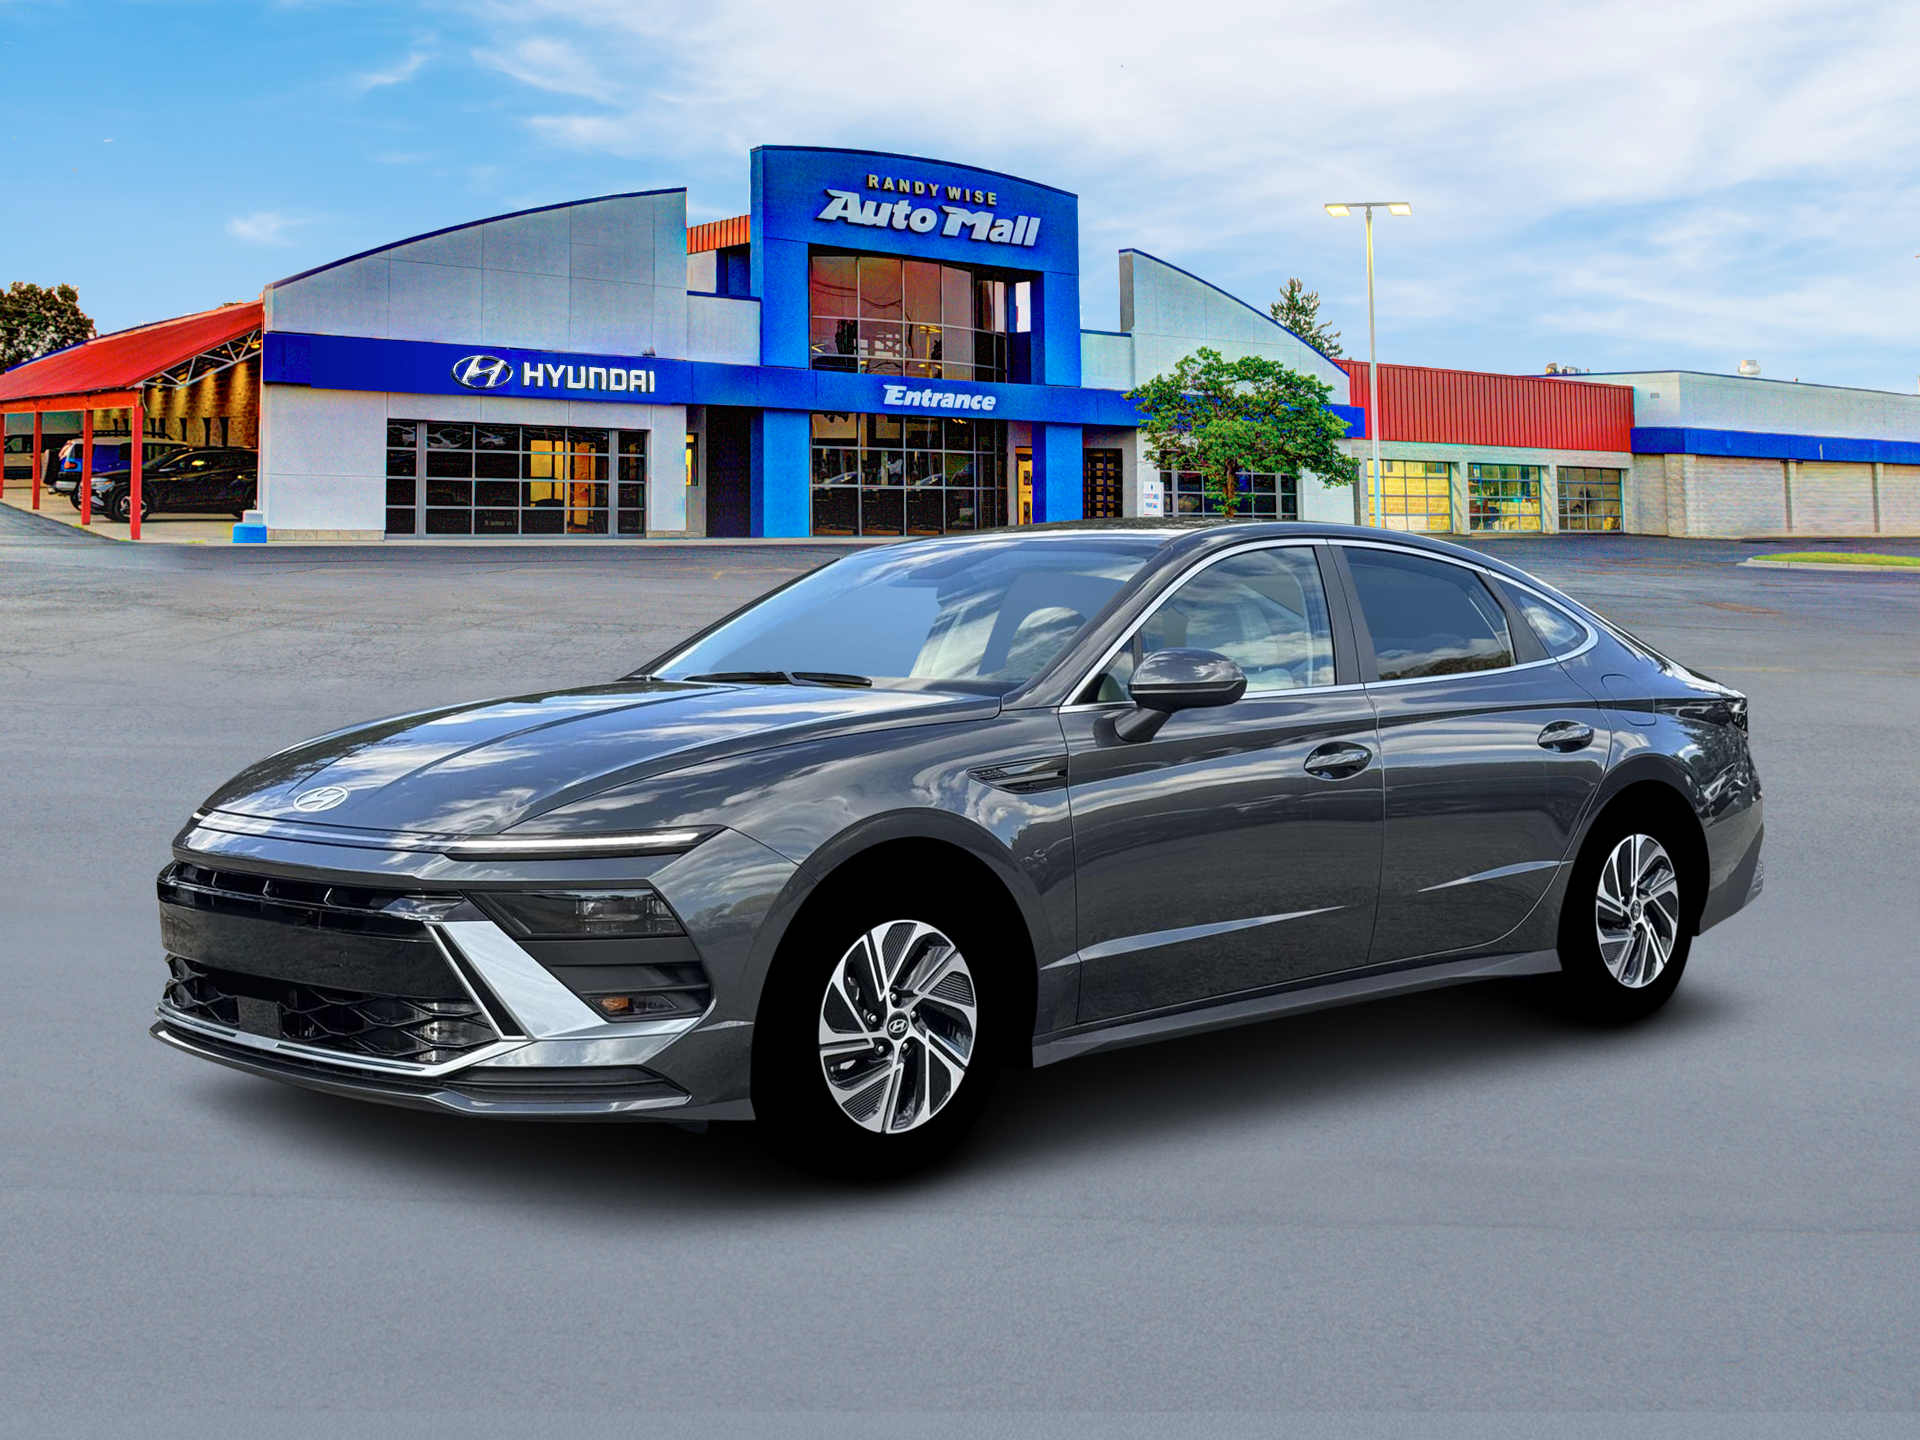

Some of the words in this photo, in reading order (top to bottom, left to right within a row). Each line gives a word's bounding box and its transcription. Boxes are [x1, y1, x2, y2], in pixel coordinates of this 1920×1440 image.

[867, 173, 939, 197] RANDY
[946, 185, 997, 206] WISE
[817, 188, 938, 233] Auto
[941, 204, 1041, 247] Mall
[521, 361, 655, 393] HYUNDAI
[882, 384, 997, 411] Entrance
